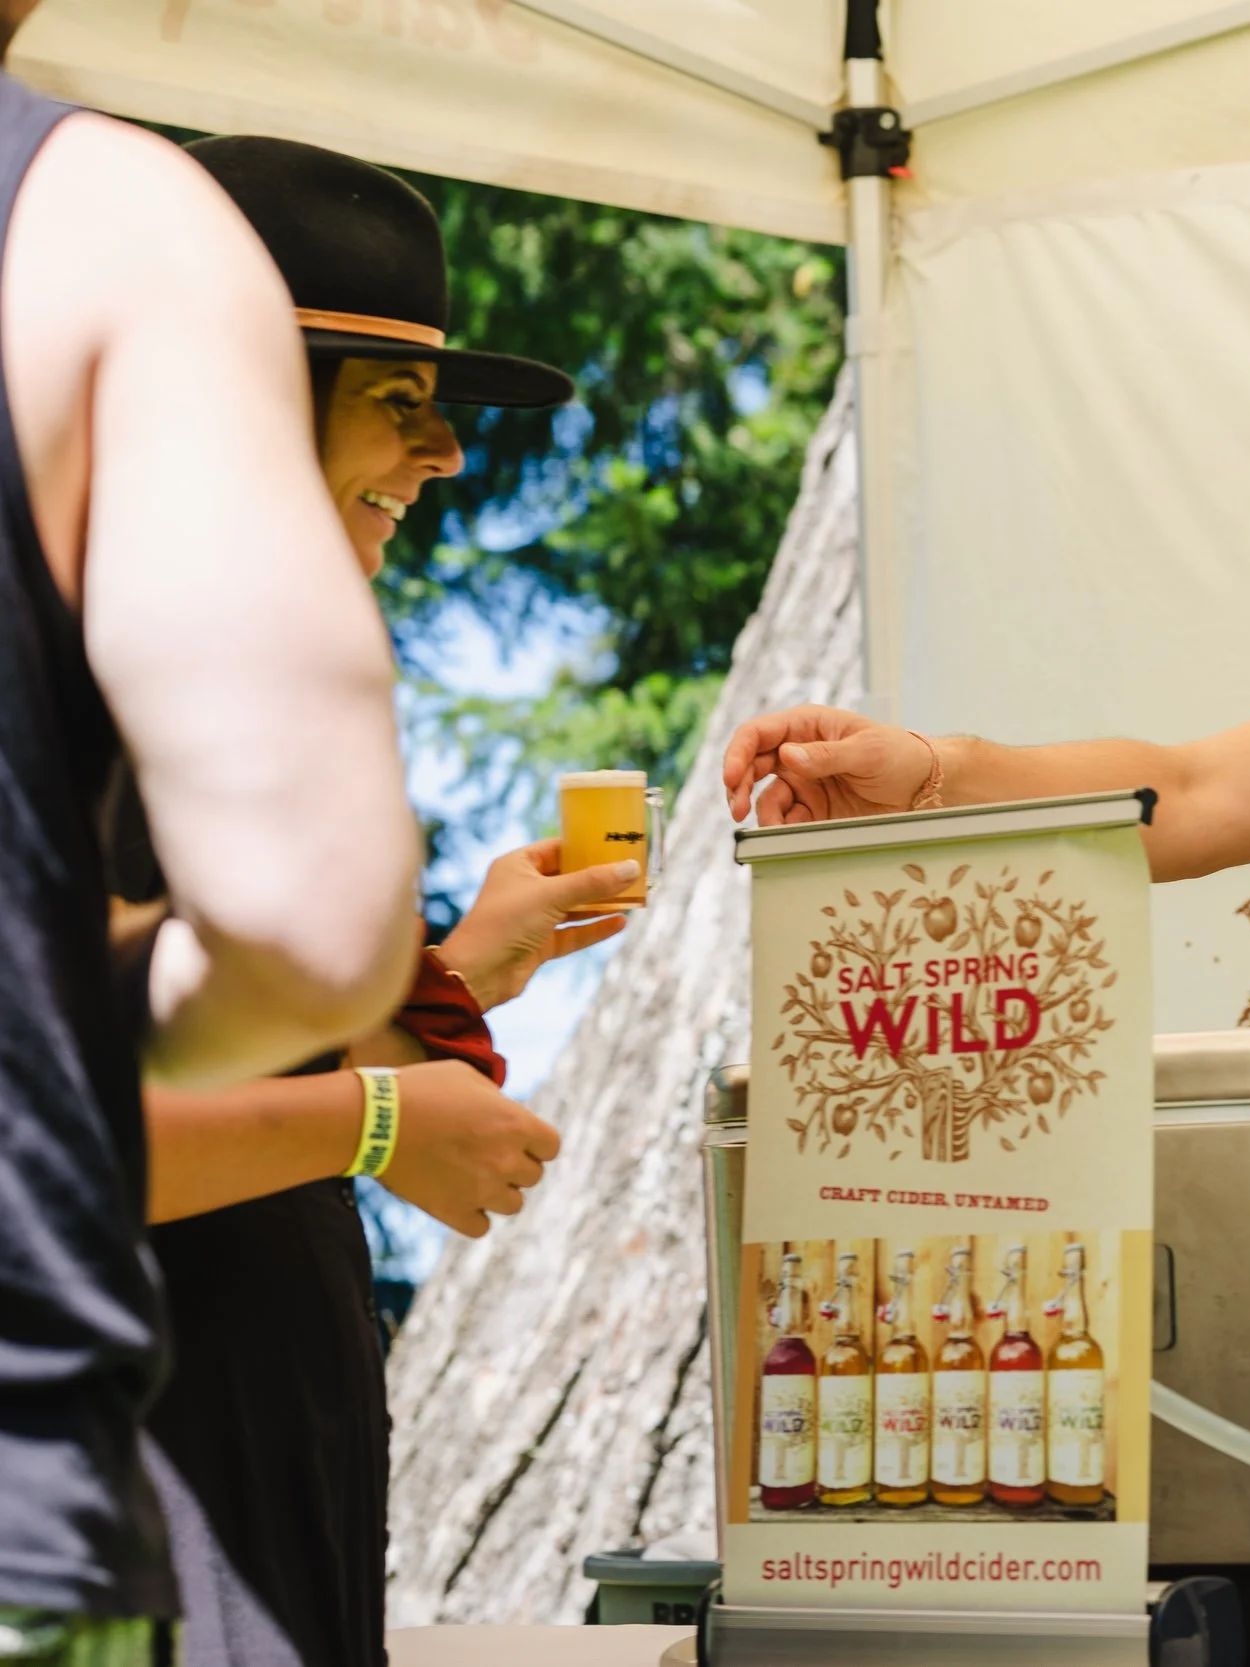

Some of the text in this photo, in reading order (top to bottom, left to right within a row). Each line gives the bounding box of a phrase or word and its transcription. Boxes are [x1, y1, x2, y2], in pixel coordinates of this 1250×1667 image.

[838, 952, 1040, 995] SALT SPRING
[839, 988, 1041, 1061] WILD
[819, 1186, 882, 1203] CRAFT
[955, 1193, 1050, 1213] UNTAMED
[762, 1552, 1102, 1588] saltspringwildcider.com
